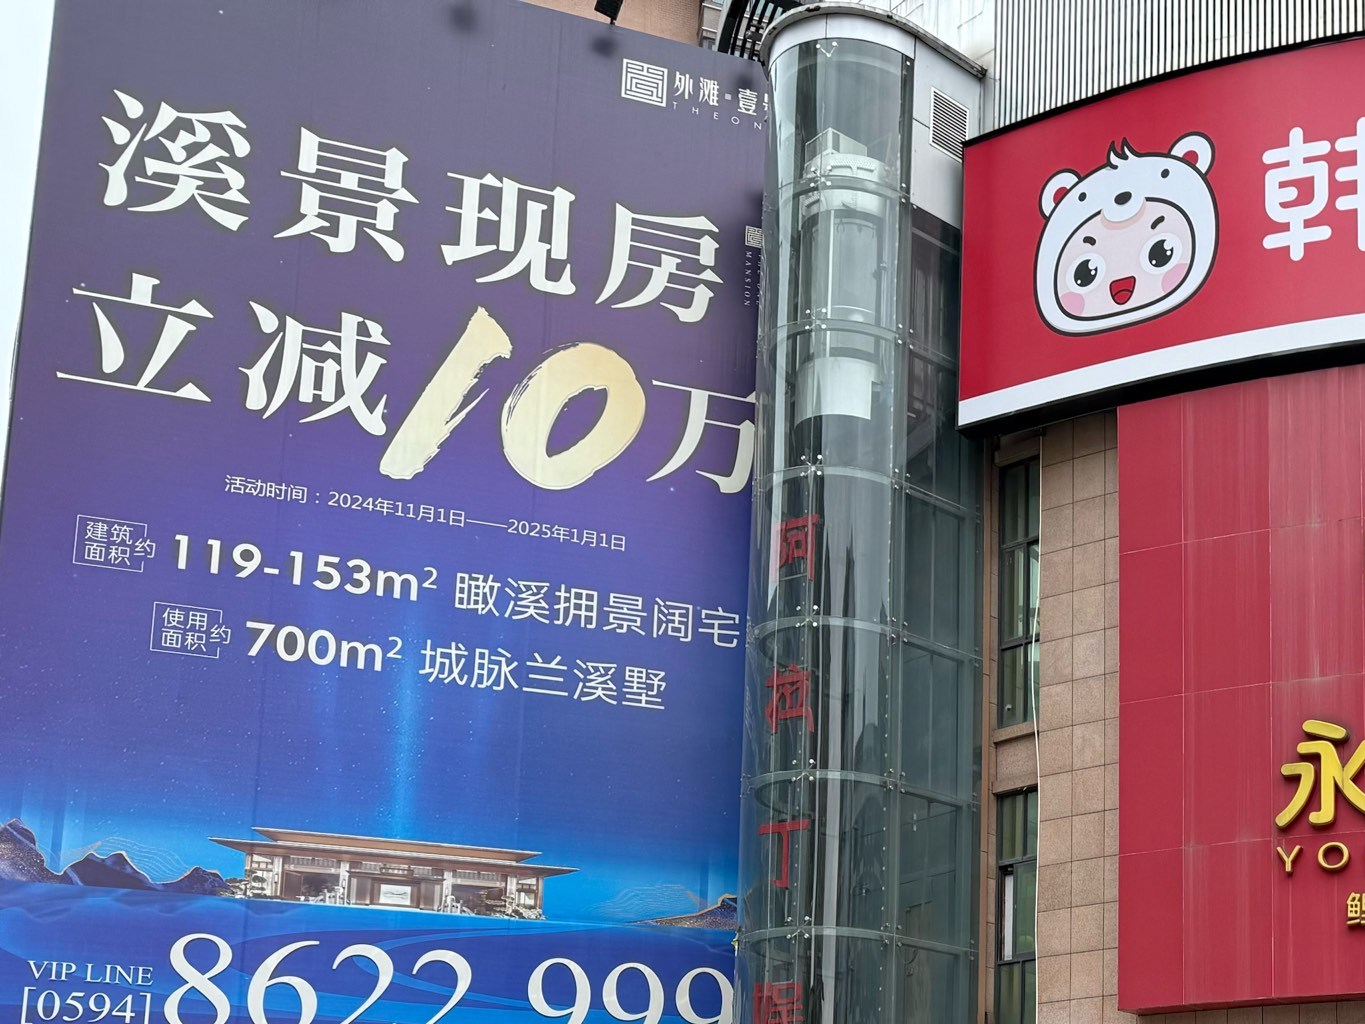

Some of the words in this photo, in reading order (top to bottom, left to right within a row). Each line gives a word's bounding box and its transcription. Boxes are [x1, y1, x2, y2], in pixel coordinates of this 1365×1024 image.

[99, 89, 725, 323] 溪景现房
[56, 273, 756, 494] 立减10万
[84, 520, 134, 545] 建筑
[84, 541, 132, 566] 面积
[162, 606, 208, 632] 使用
[455, 572, 741, 648] 瞰溪拥景阔宅
[162, 628, 207, 652] 面积
[420, 639, 667, 710] 城脉兰溪墅
[28, 960, 79, 983] VIP
[85, 962, 154, 987] LINE
